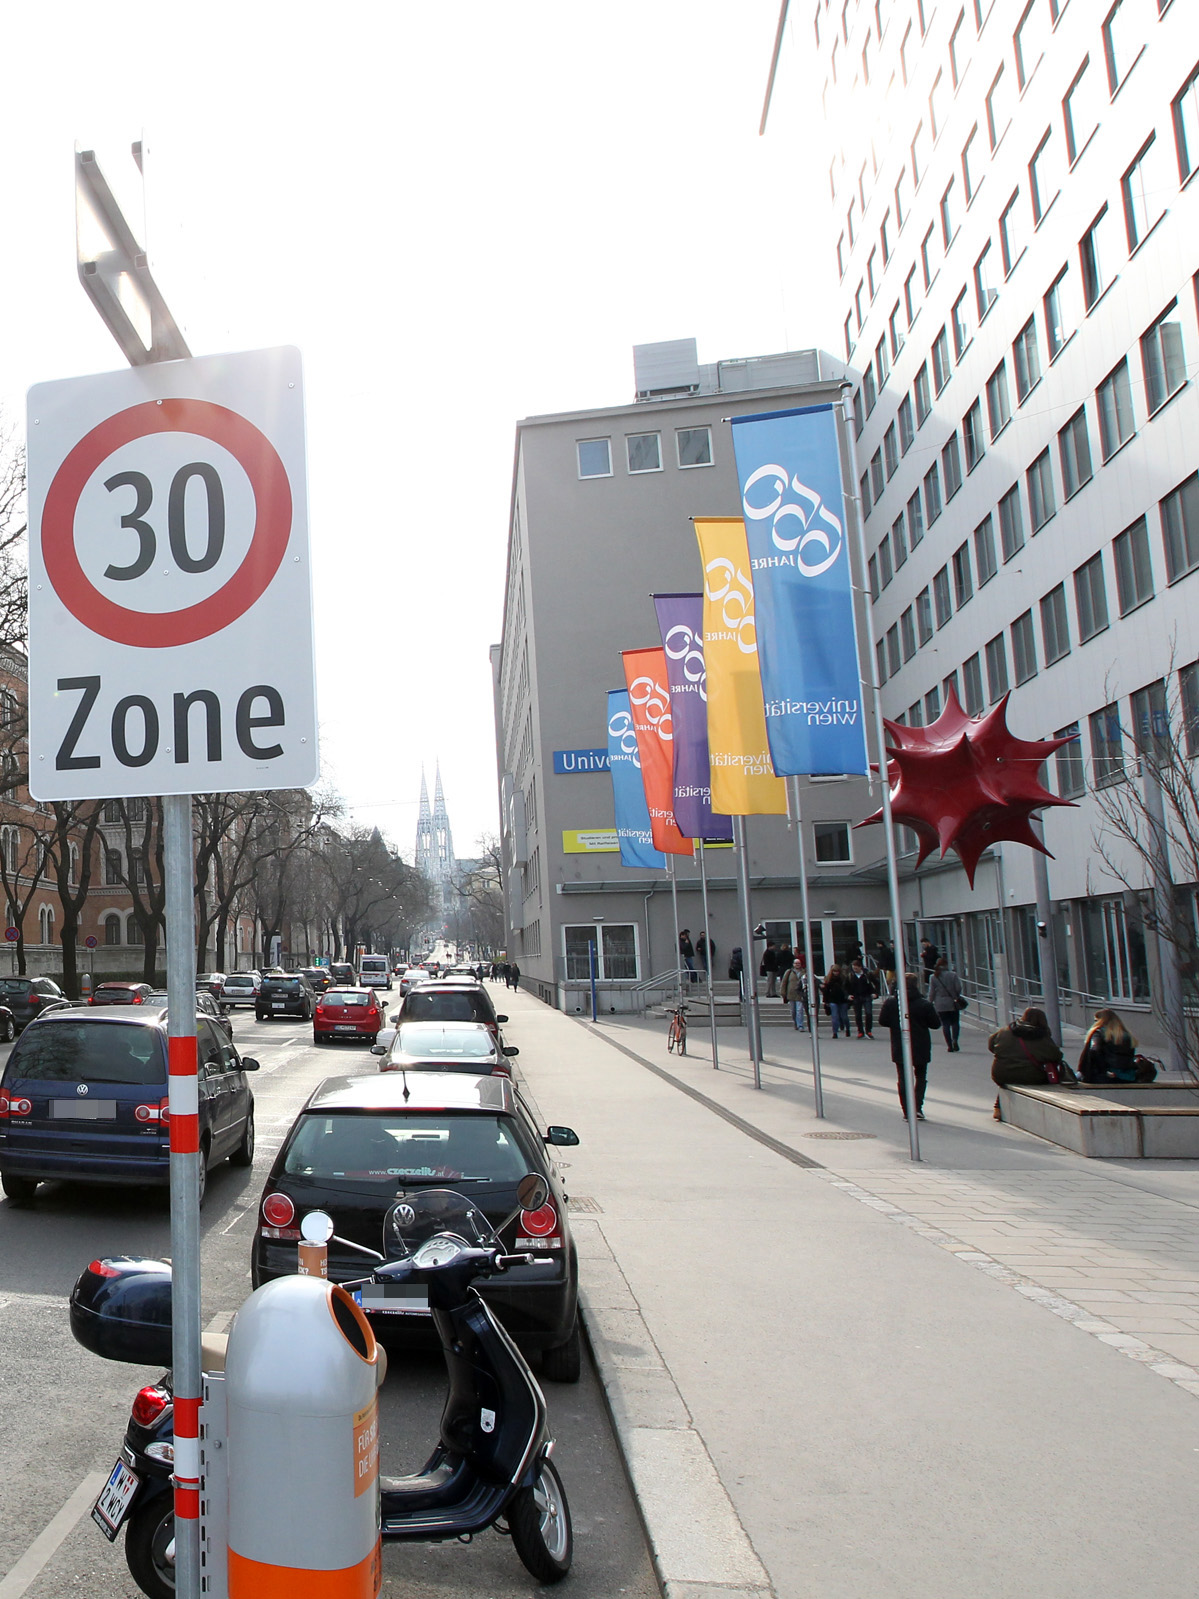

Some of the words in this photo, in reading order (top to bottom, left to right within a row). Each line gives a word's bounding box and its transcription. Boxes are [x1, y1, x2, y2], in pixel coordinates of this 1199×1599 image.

[103, 461, 225, 581] 30
[55, 674, 286, 771] Zone
[100, 1487, 112, 1507] 2
[106, 1492, 125, 1522] WCY
[116, 1470, 128, 1492] W
